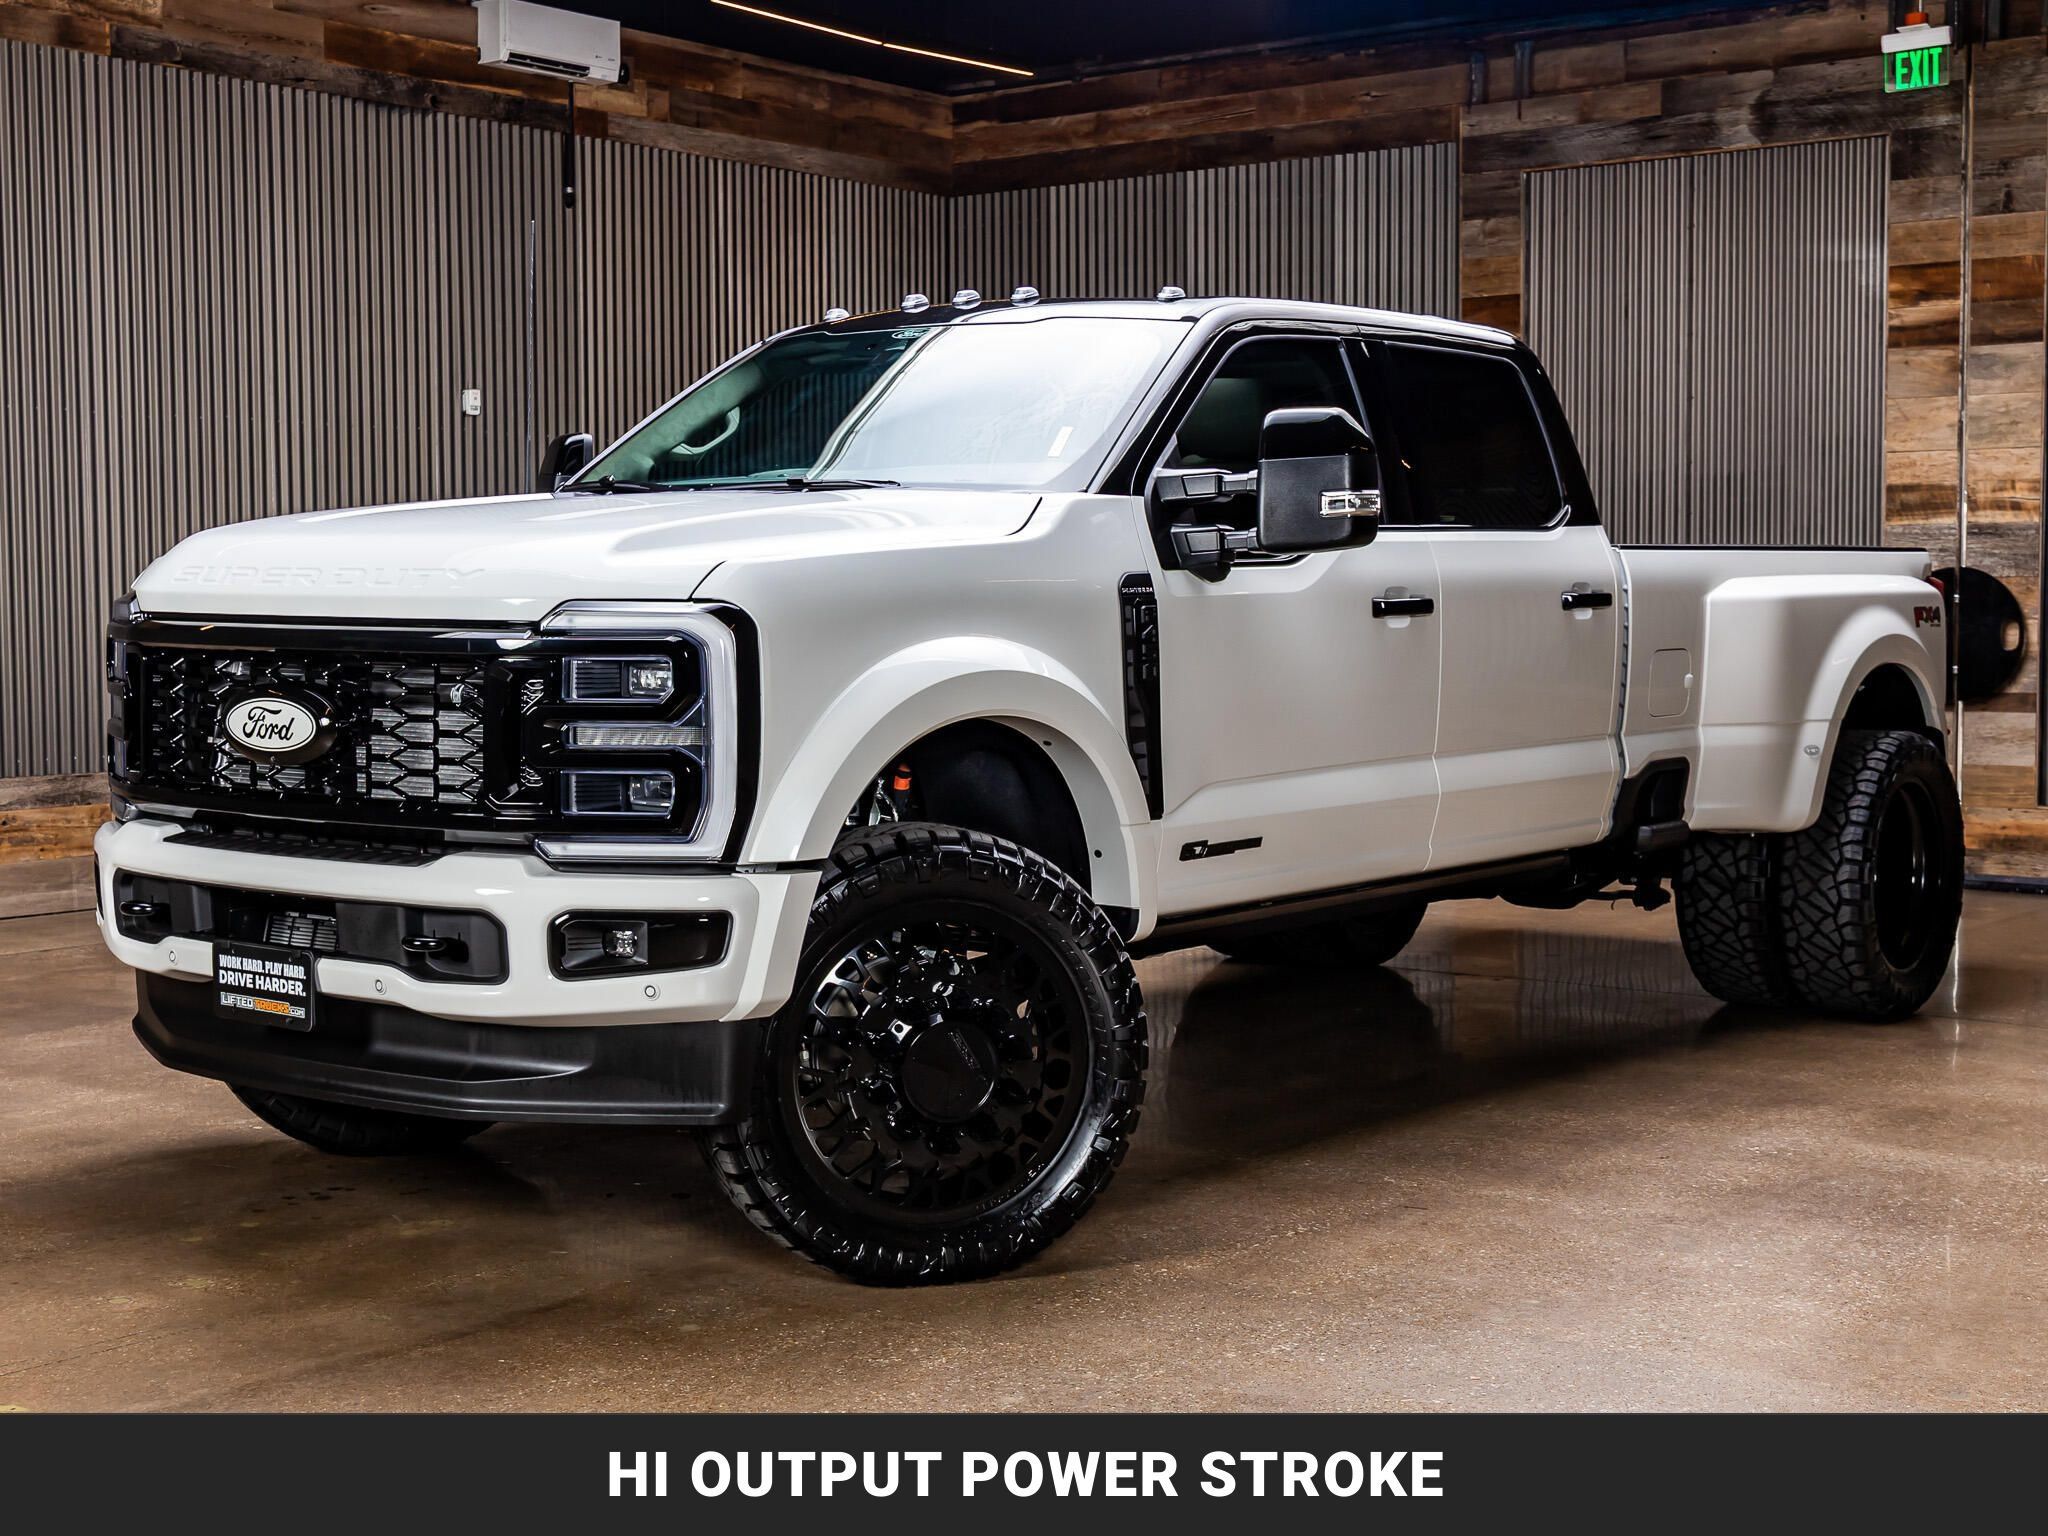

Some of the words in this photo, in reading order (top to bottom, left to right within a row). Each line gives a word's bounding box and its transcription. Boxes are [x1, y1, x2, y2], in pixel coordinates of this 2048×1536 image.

[1895, 47, 1943, 90] EXIT
[171, 565, 323, 586] SUPER
[325, 566, 487, 589] DUTY
[242, 706, 295, 741] Ford
[219, 954, 242, 970] WORK
[242, 957, 265, 973] HARD.
[265, 961, 283, 976] PLAY
[283, 964, 307, 980] HARD.
[219, 969, 254, 989] DRIVE
[255, 975, 307, 997] HARDER.
